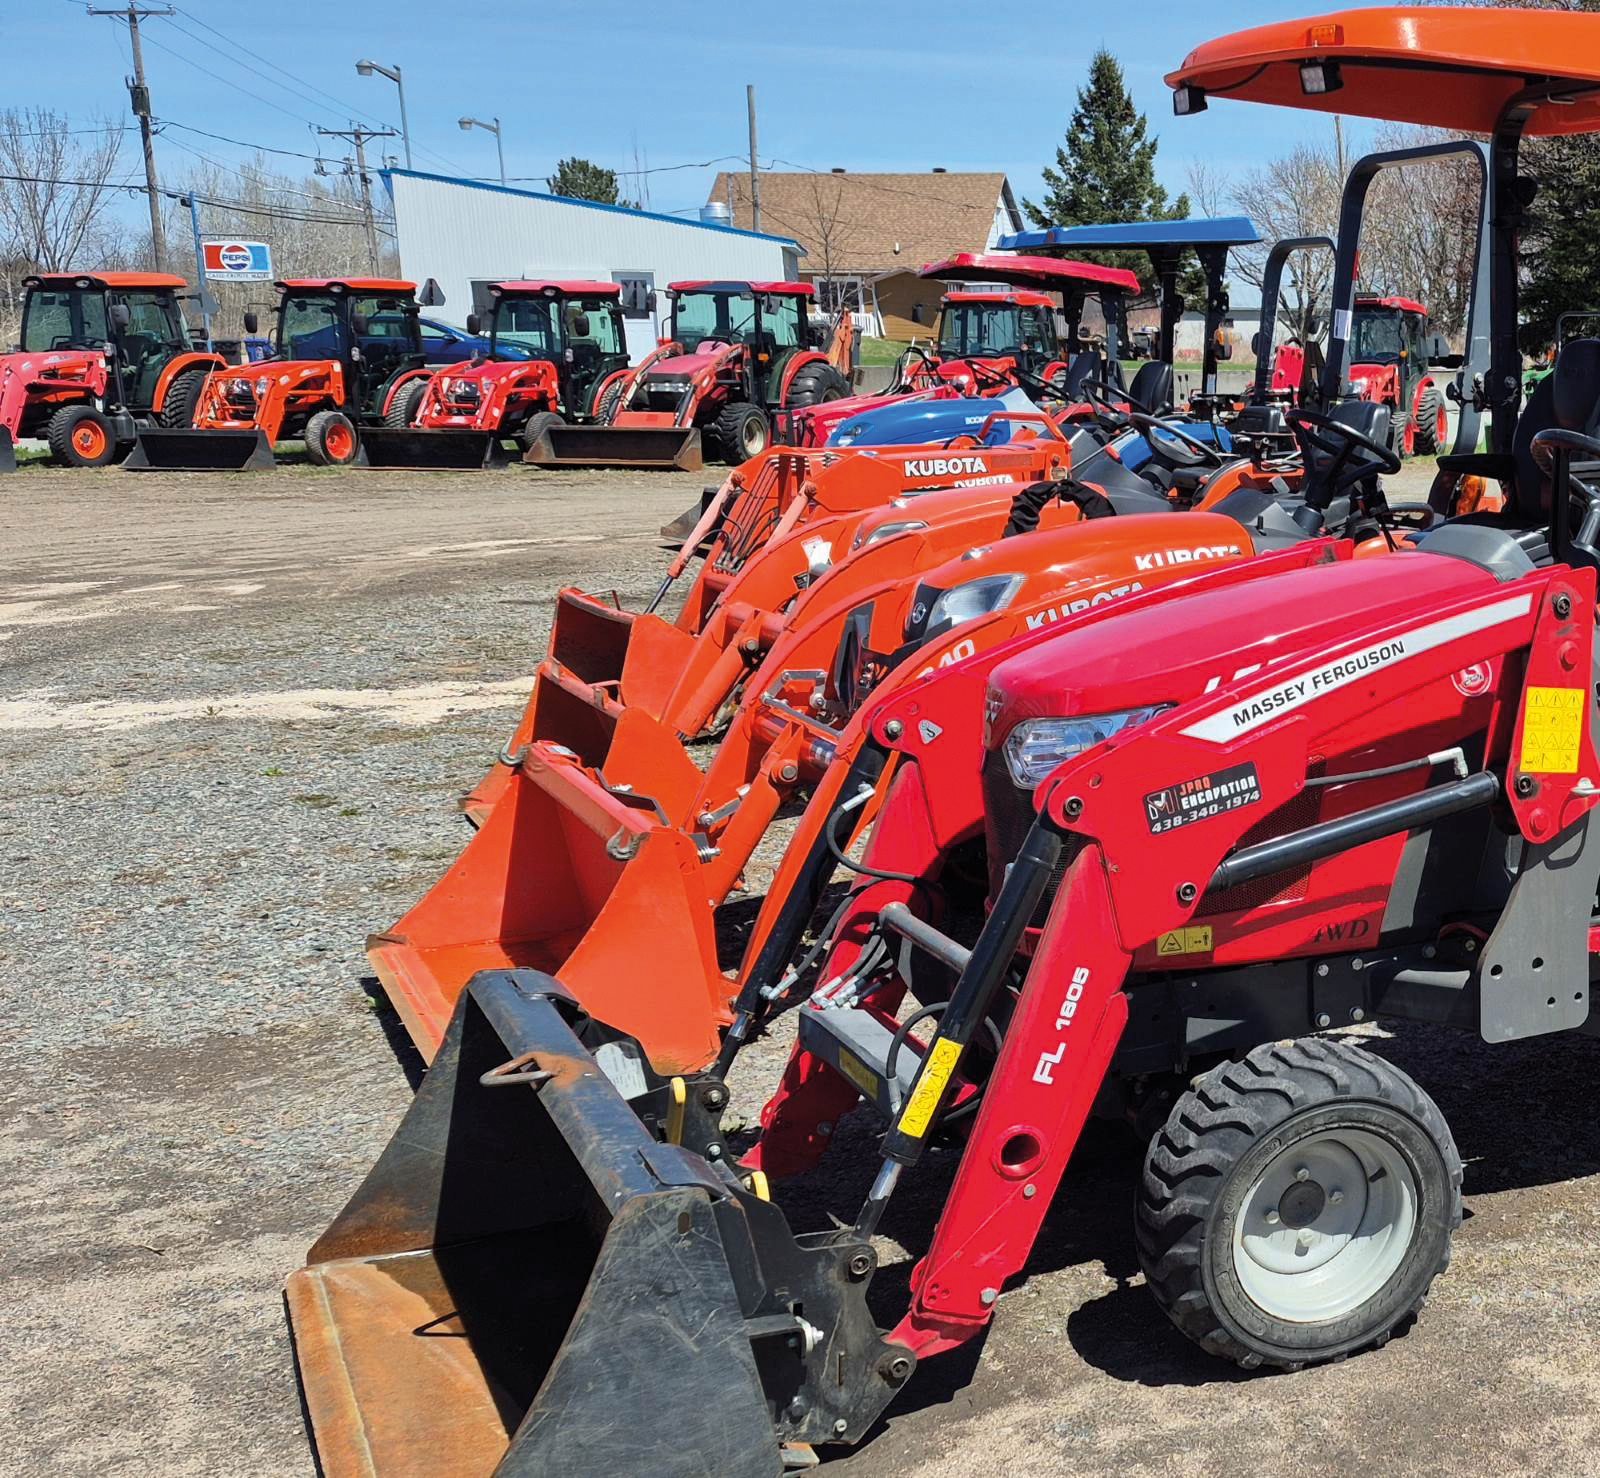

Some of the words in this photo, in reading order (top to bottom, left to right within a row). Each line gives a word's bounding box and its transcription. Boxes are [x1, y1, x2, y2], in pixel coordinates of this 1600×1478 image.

[222, 254, 251, 262] PEPSI
[904, 457, 988, 478] KUBOTA
[1232, 681, 1306, 727] MASSEY
[1311, 640, 1406, 691] FERGUSON
[1151, 789, 1261, 833] 438-340-1974
[1032, 1042, 1067, 1085] FL
[1055, 966, 1090, 1031] 1805
